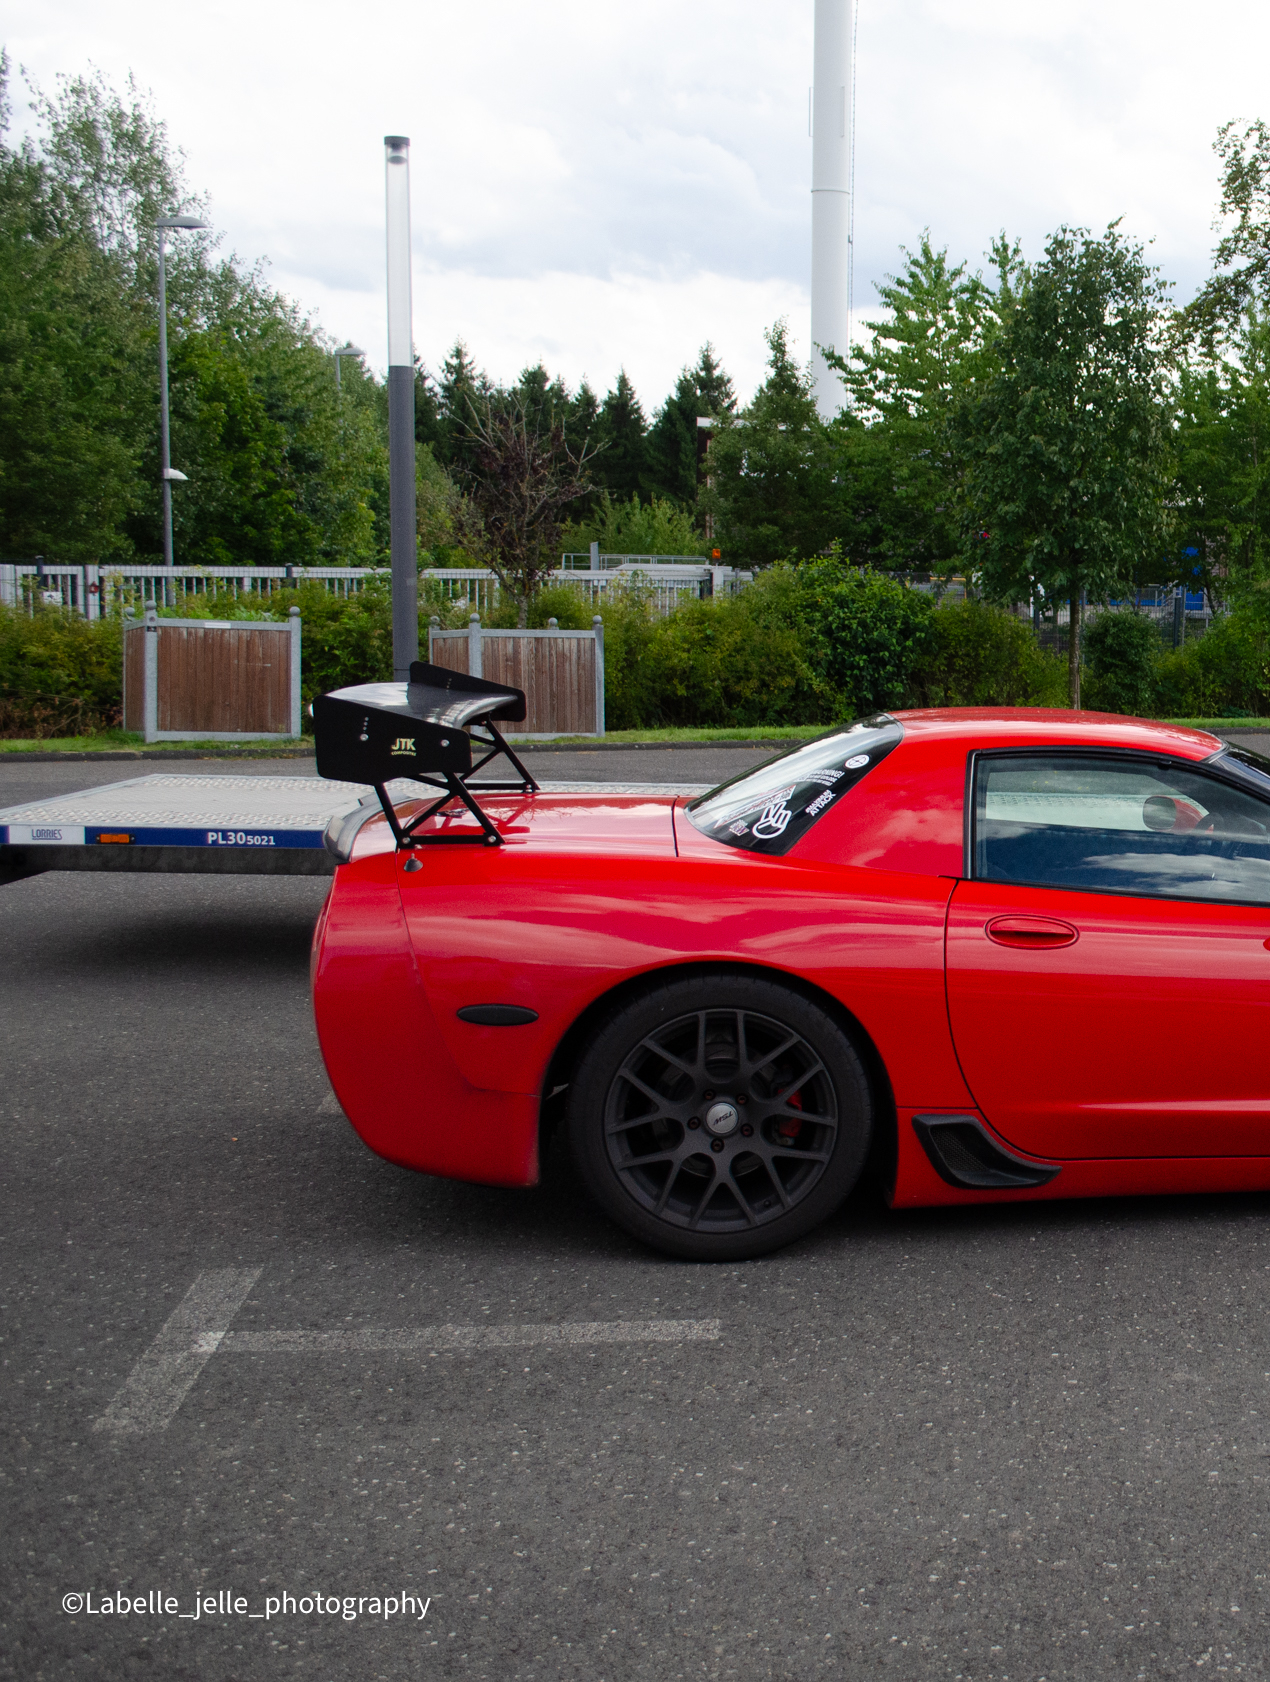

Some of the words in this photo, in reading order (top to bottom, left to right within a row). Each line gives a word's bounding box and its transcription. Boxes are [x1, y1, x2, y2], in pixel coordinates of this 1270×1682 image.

[391, 738, 416, 750] JTK
[810, 793, 837, 817] ATTACK
[32, 829, 63, 840] LORRIES
